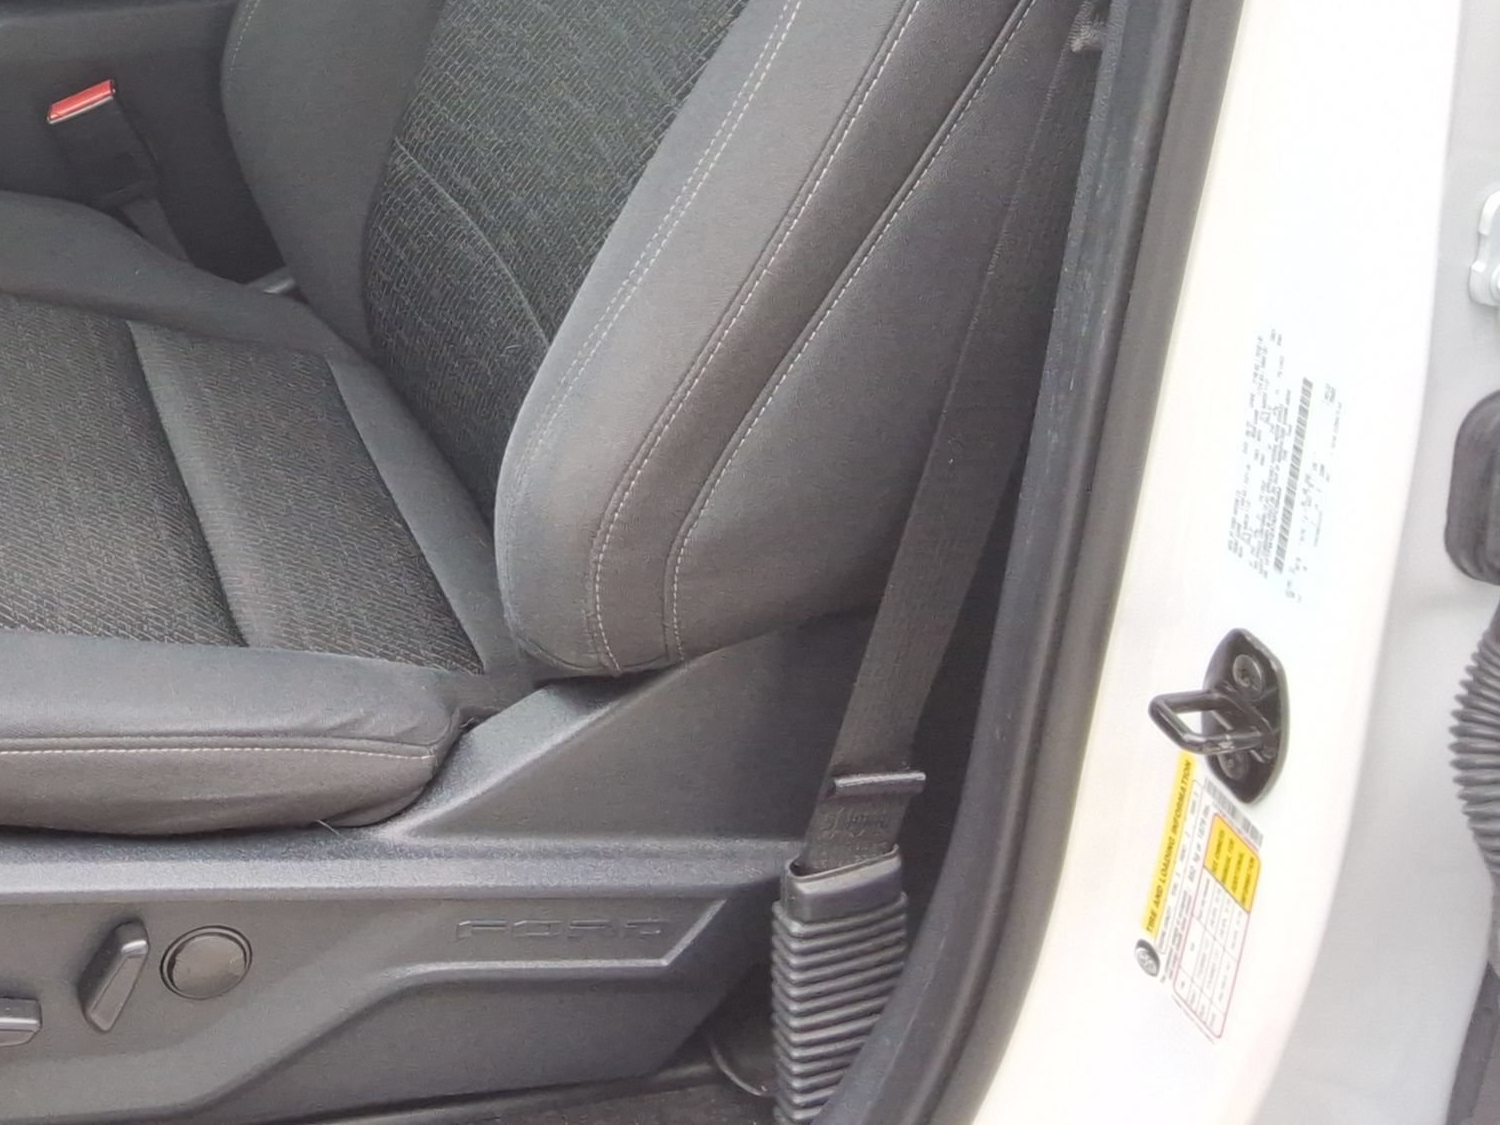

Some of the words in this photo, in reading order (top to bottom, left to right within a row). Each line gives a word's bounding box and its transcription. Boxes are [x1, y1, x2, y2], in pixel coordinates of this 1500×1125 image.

[1146, 909, 1158, 933] TIRE
[1153, 884, 1164, 908] AND
[1159, 836, 1176, 884] LOADING
[1171, 759, 1192, 836] INFORMATION
